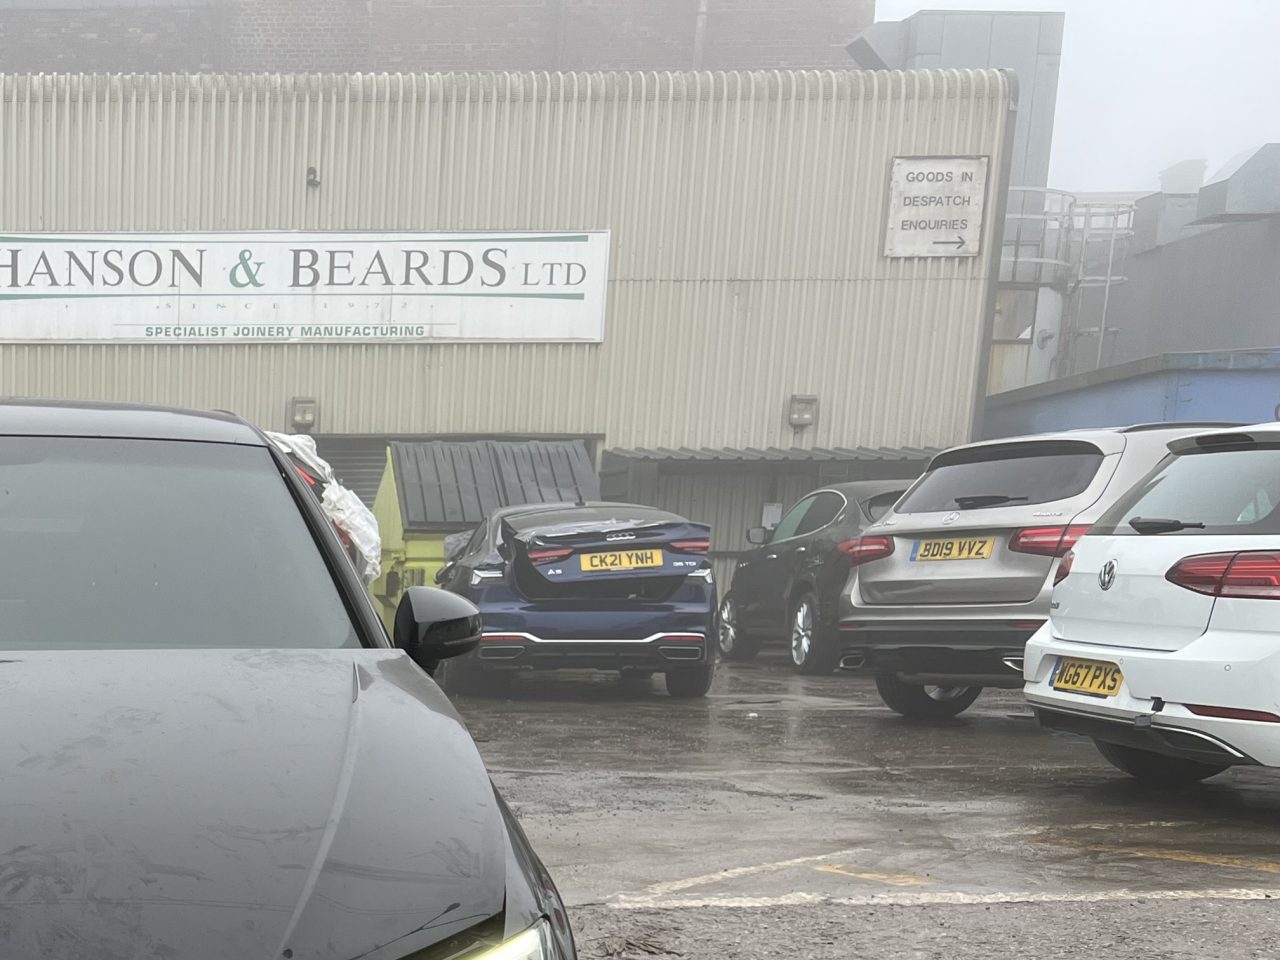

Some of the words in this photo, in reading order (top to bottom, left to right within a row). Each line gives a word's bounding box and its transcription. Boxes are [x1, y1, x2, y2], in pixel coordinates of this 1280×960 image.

[906, 172, 953, 182] GOODS
[961, 172, 974, 182] IN
[903, 196, 971, 206] DESPATCH
[901, 219, 968, 231] ENQUIRIES
[228, 248, 266, 289] &
[287, 247, 510, 288] BEARDS
[520, 262, 588, 286] LTD
[145, 327, 228, 337] SPECIALIST
[233, 327, 295, 337] JOINERY
[300, 326, 426, 337] MANUFACTURING
[919, 541, 954, 557] BD19
[958, 540, 987, 556] VVZ
[589, 553, 623, 568] CK21
[625, 551, 654, 566] YNH
[1056, 661, 1093, 687] WG67
[1089, 665, 1122, 691] PXS
